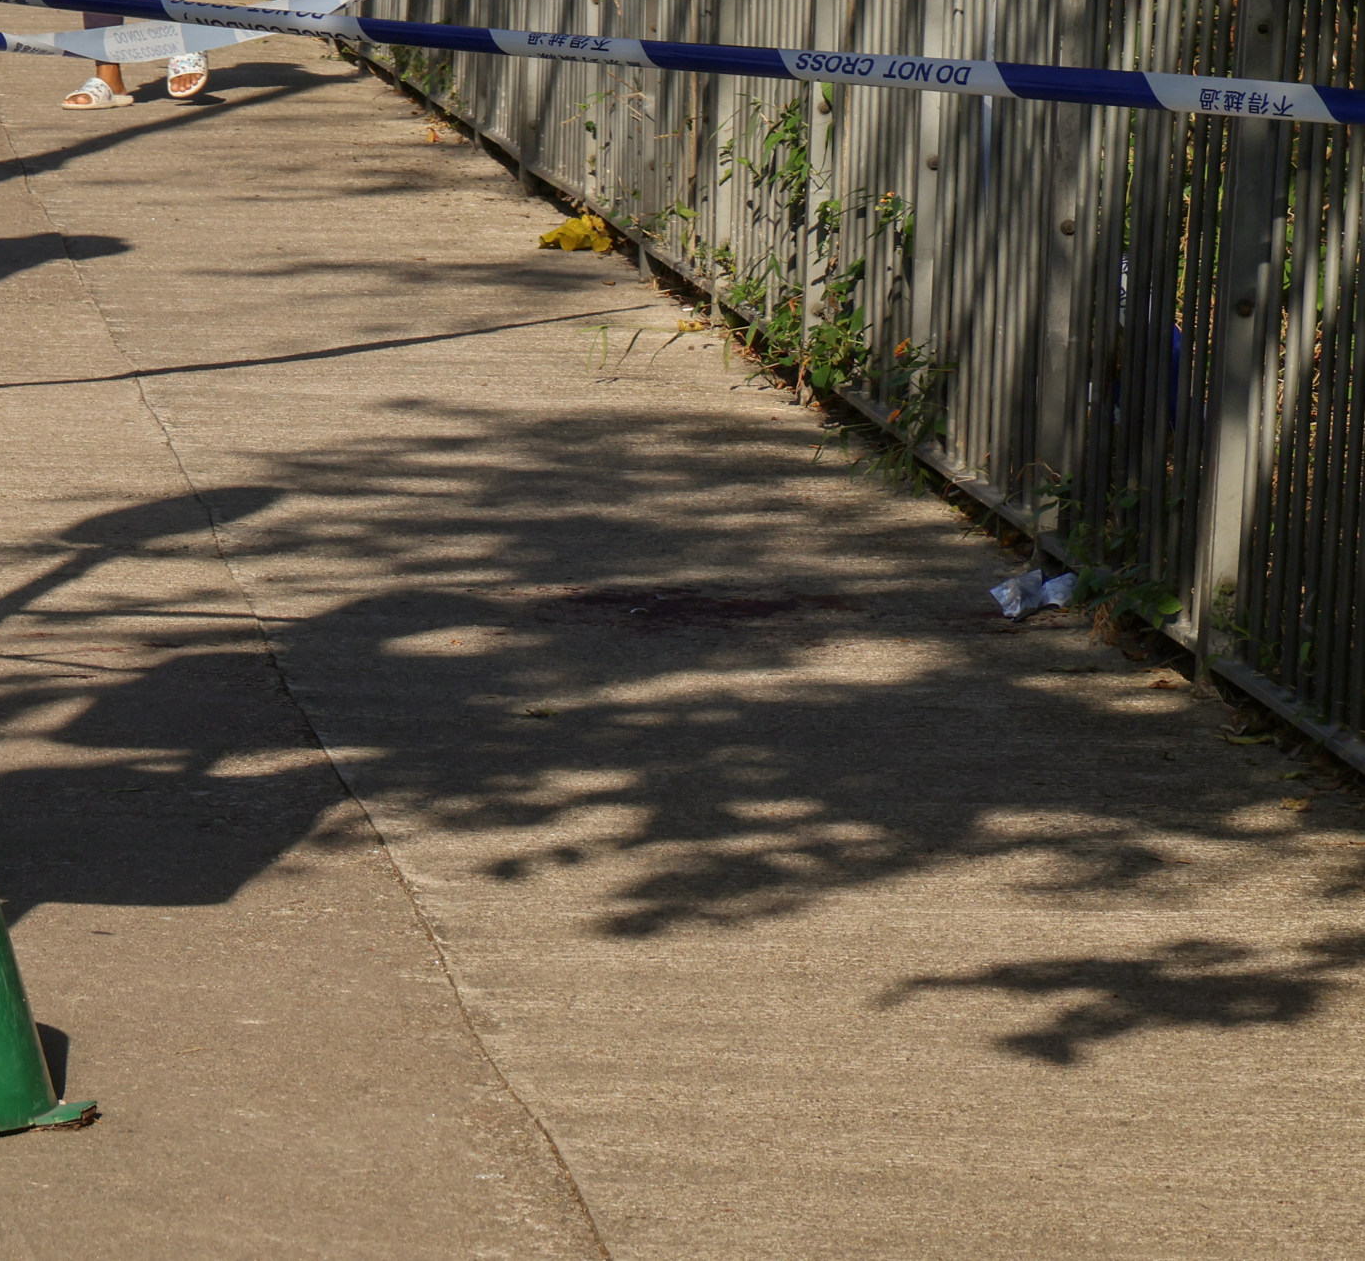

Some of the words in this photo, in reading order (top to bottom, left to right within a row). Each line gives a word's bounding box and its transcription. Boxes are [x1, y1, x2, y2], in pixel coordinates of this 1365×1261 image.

[795, 53, 874, 76] CROSS
[883, 59, 933, 83] NOT
[940, 64, 972, 86] DO
[1200, 88, 1294, 117] 不得越過
